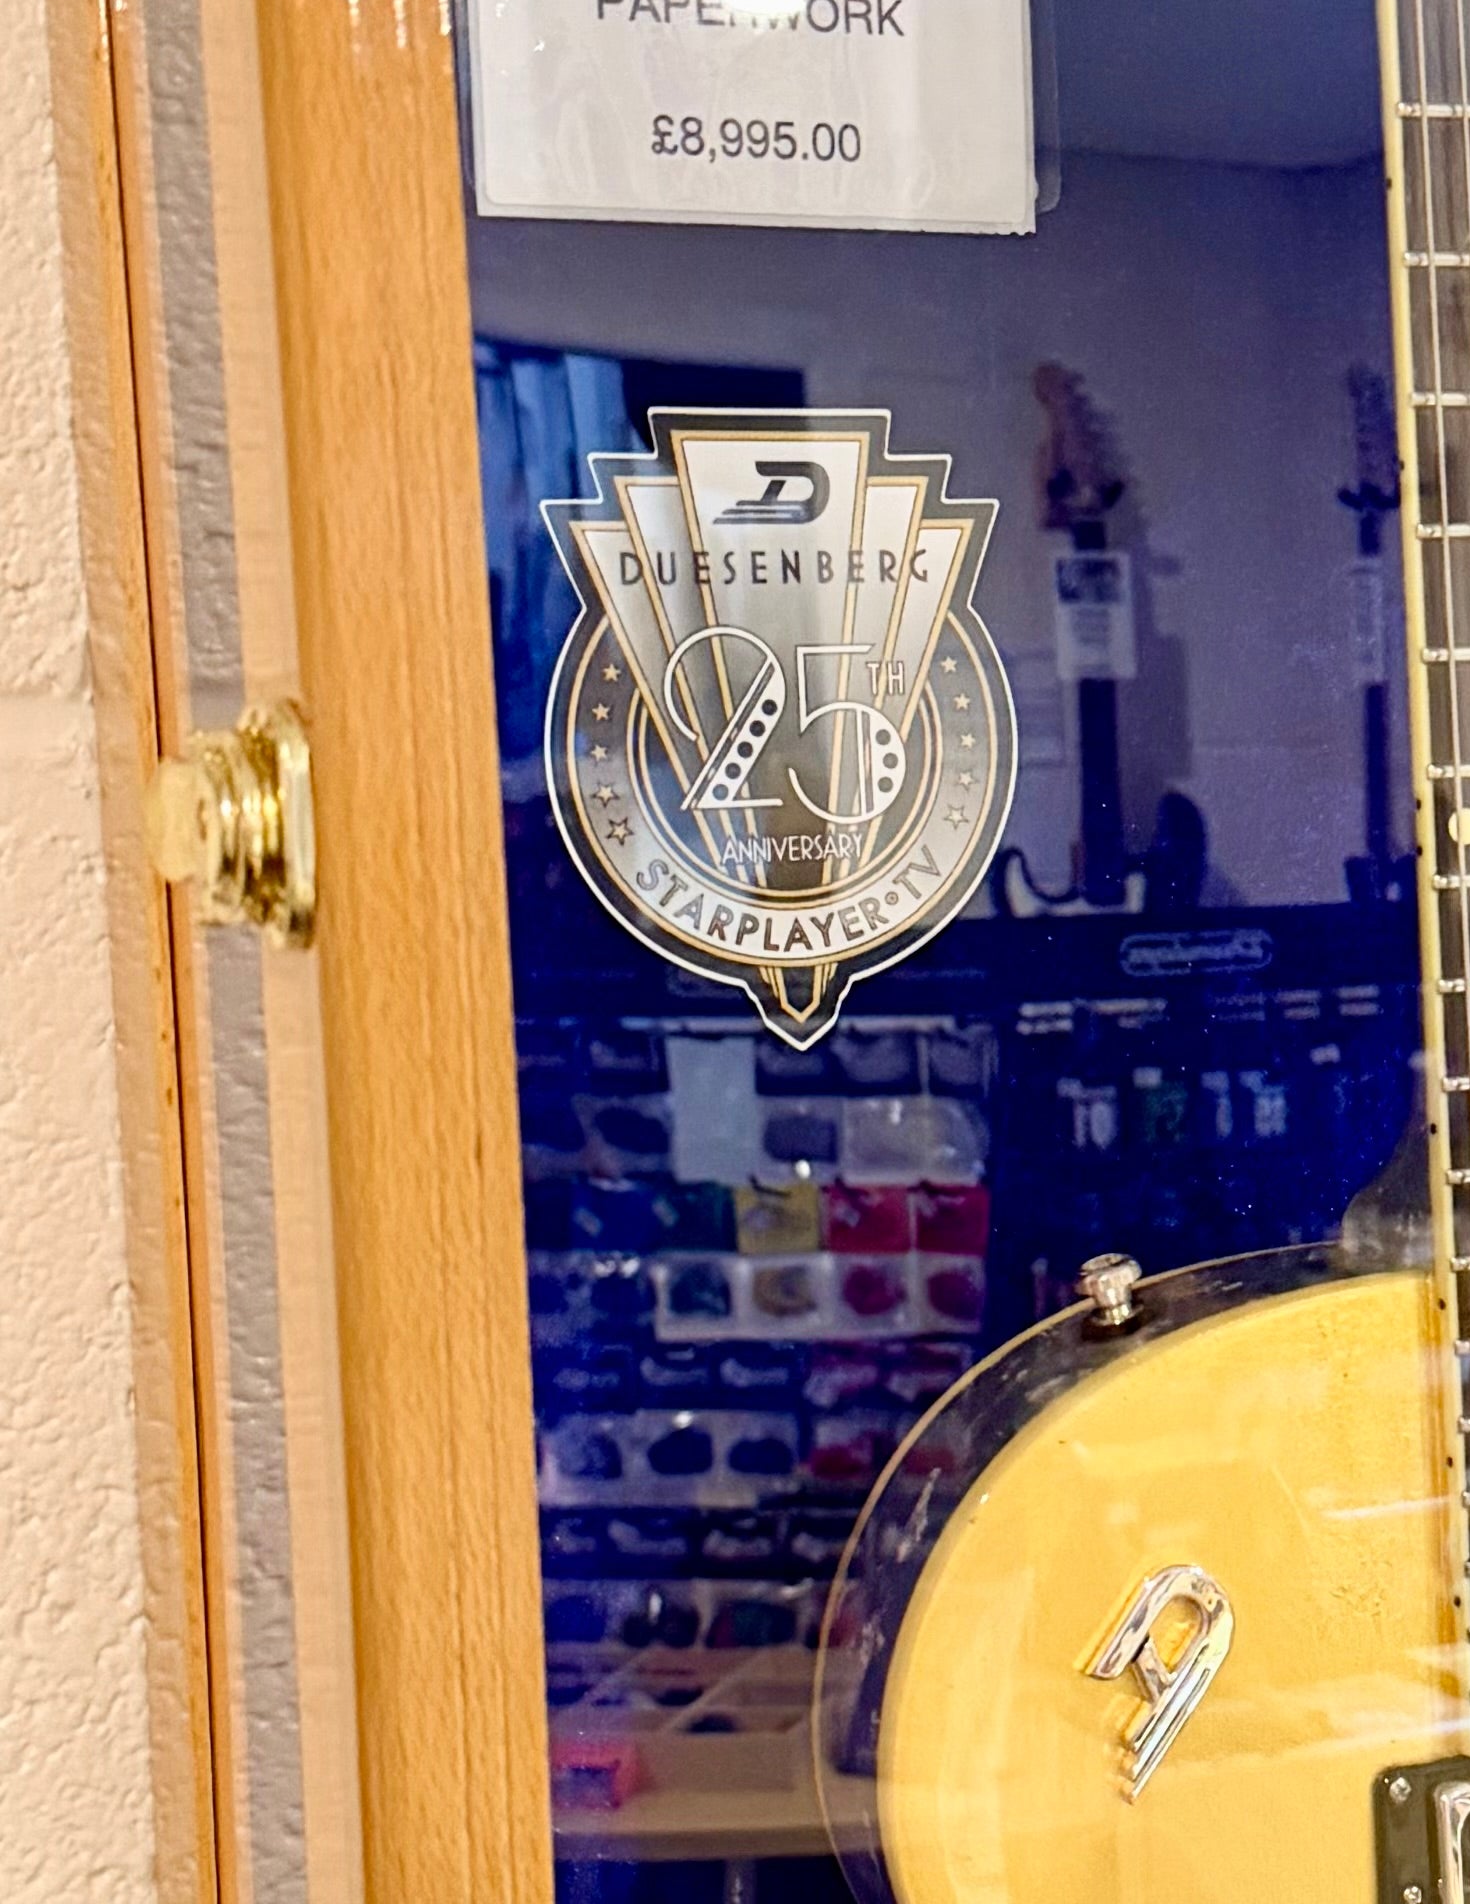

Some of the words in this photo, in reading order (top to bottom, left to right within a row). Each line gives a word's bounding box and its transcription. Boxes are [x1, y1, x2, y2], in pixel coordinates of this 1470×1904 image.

[652, 116, 861, 164] £8,995.00
[621, 549, 928, 585] DUESENBERG
[720, 832, 864, 866] ANNIVERSARY
